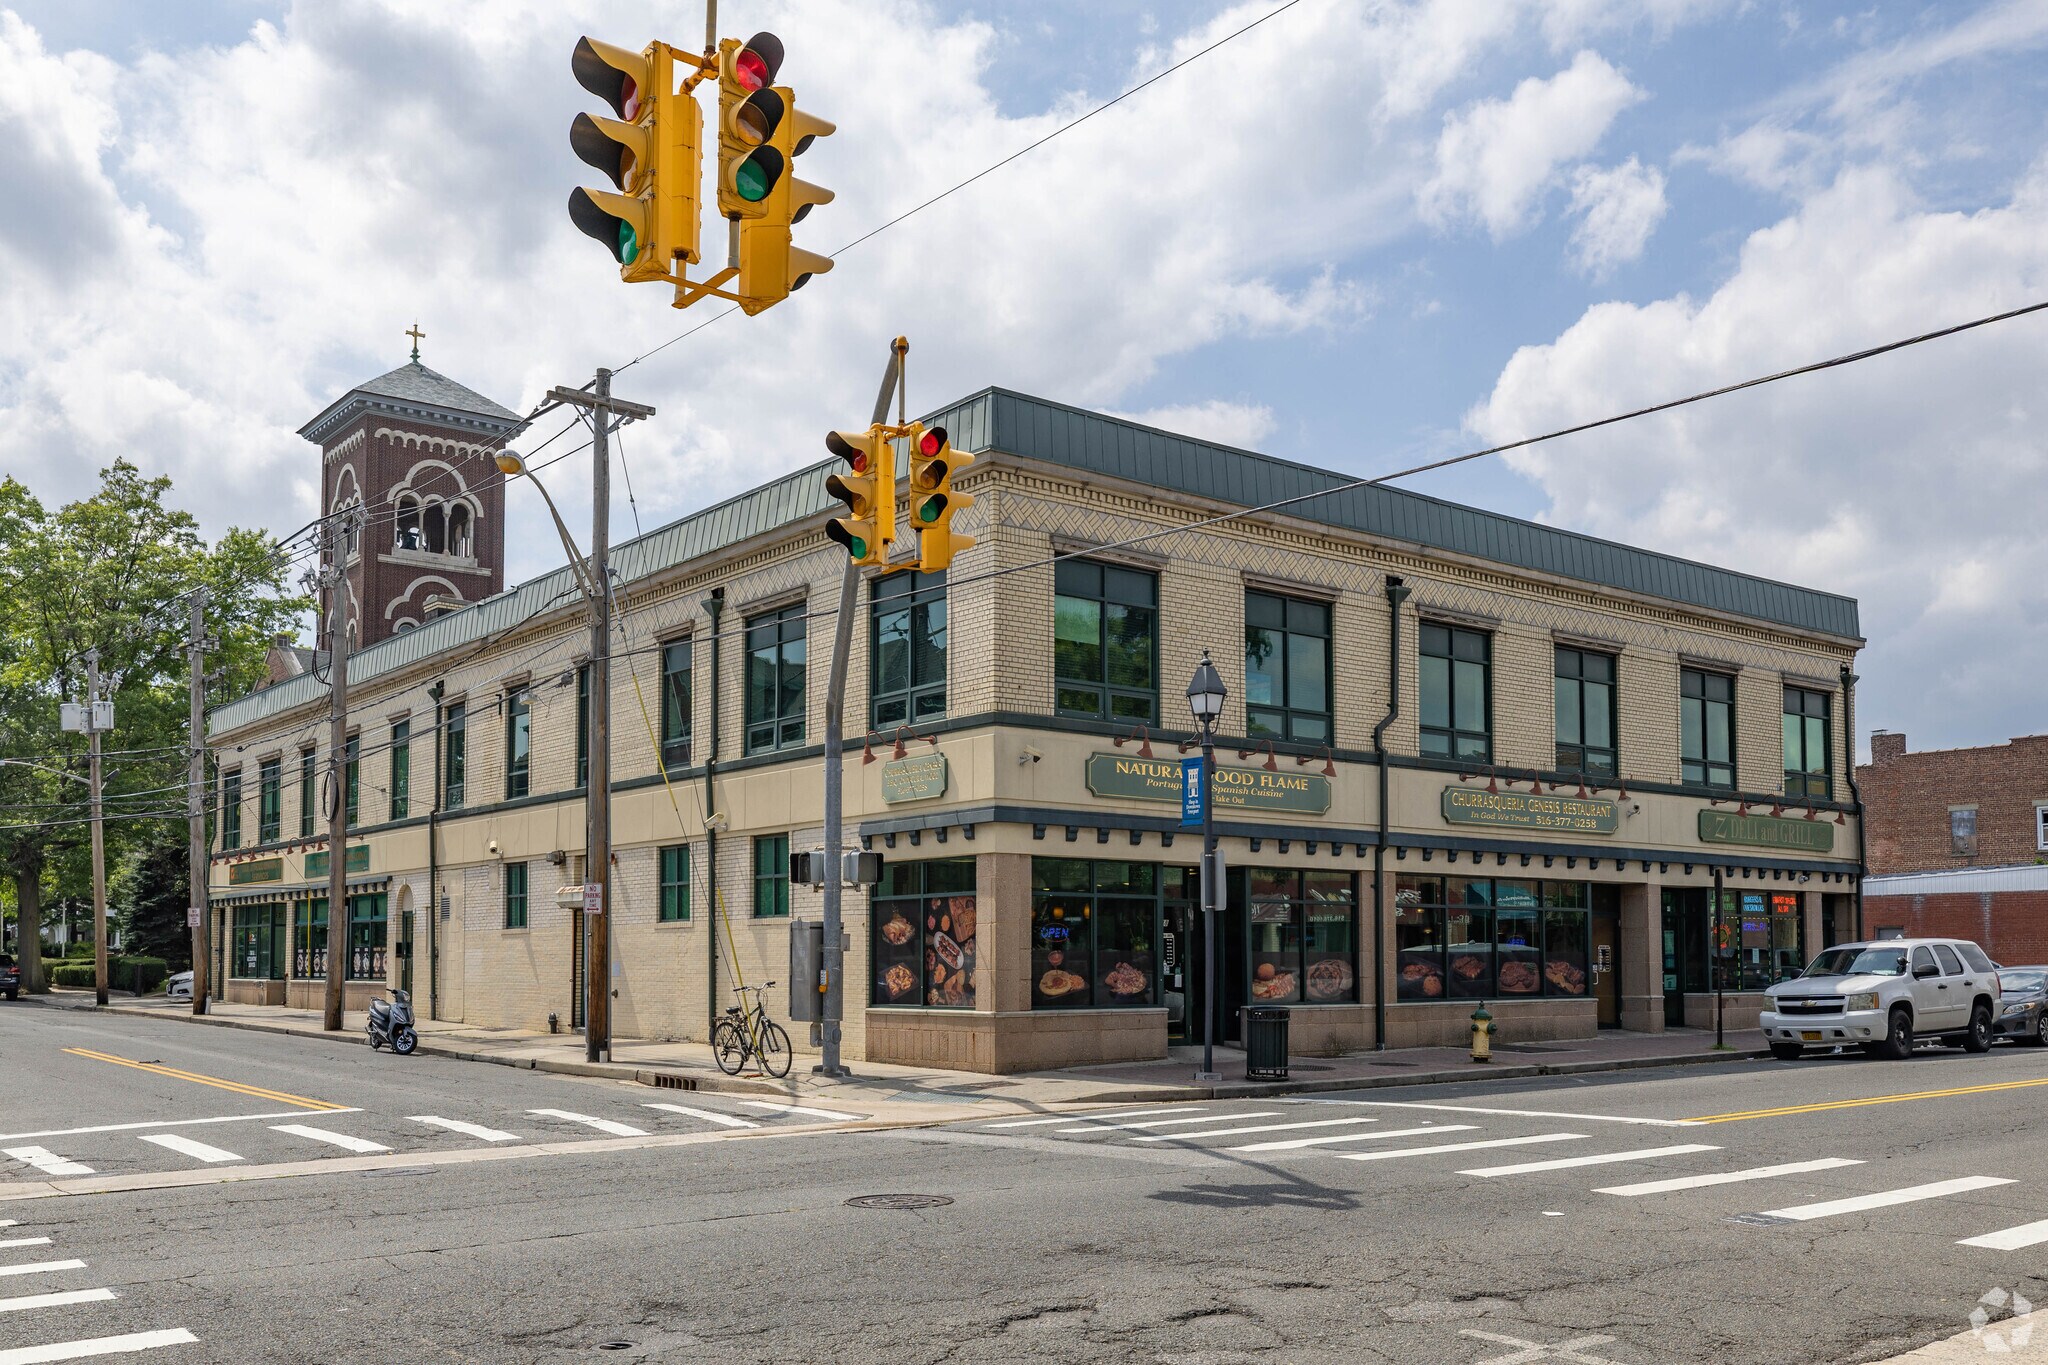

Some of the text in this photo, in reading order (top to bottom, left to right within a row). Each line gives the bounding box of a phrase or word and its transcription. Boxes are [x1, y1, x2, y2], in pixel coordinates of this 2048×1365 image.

[1116, 761, 1309, 791] NATURA OOD FLAME
[1212, 784, 1249, 796] Spanish
[1250, 787, 1284, 799] Cuisine
[1232, 796, 1245, 804] Out
[1452, 792, 1611, 818] CHURRASQUERIA GENESIS RESTAURANT
[1471, 811, 1597, 828] In God We Trust 516-377-0258
[1714, 816, 1814, 845] Z DELI and GRILL
[1041, 927, 1069, 938] OPEN
